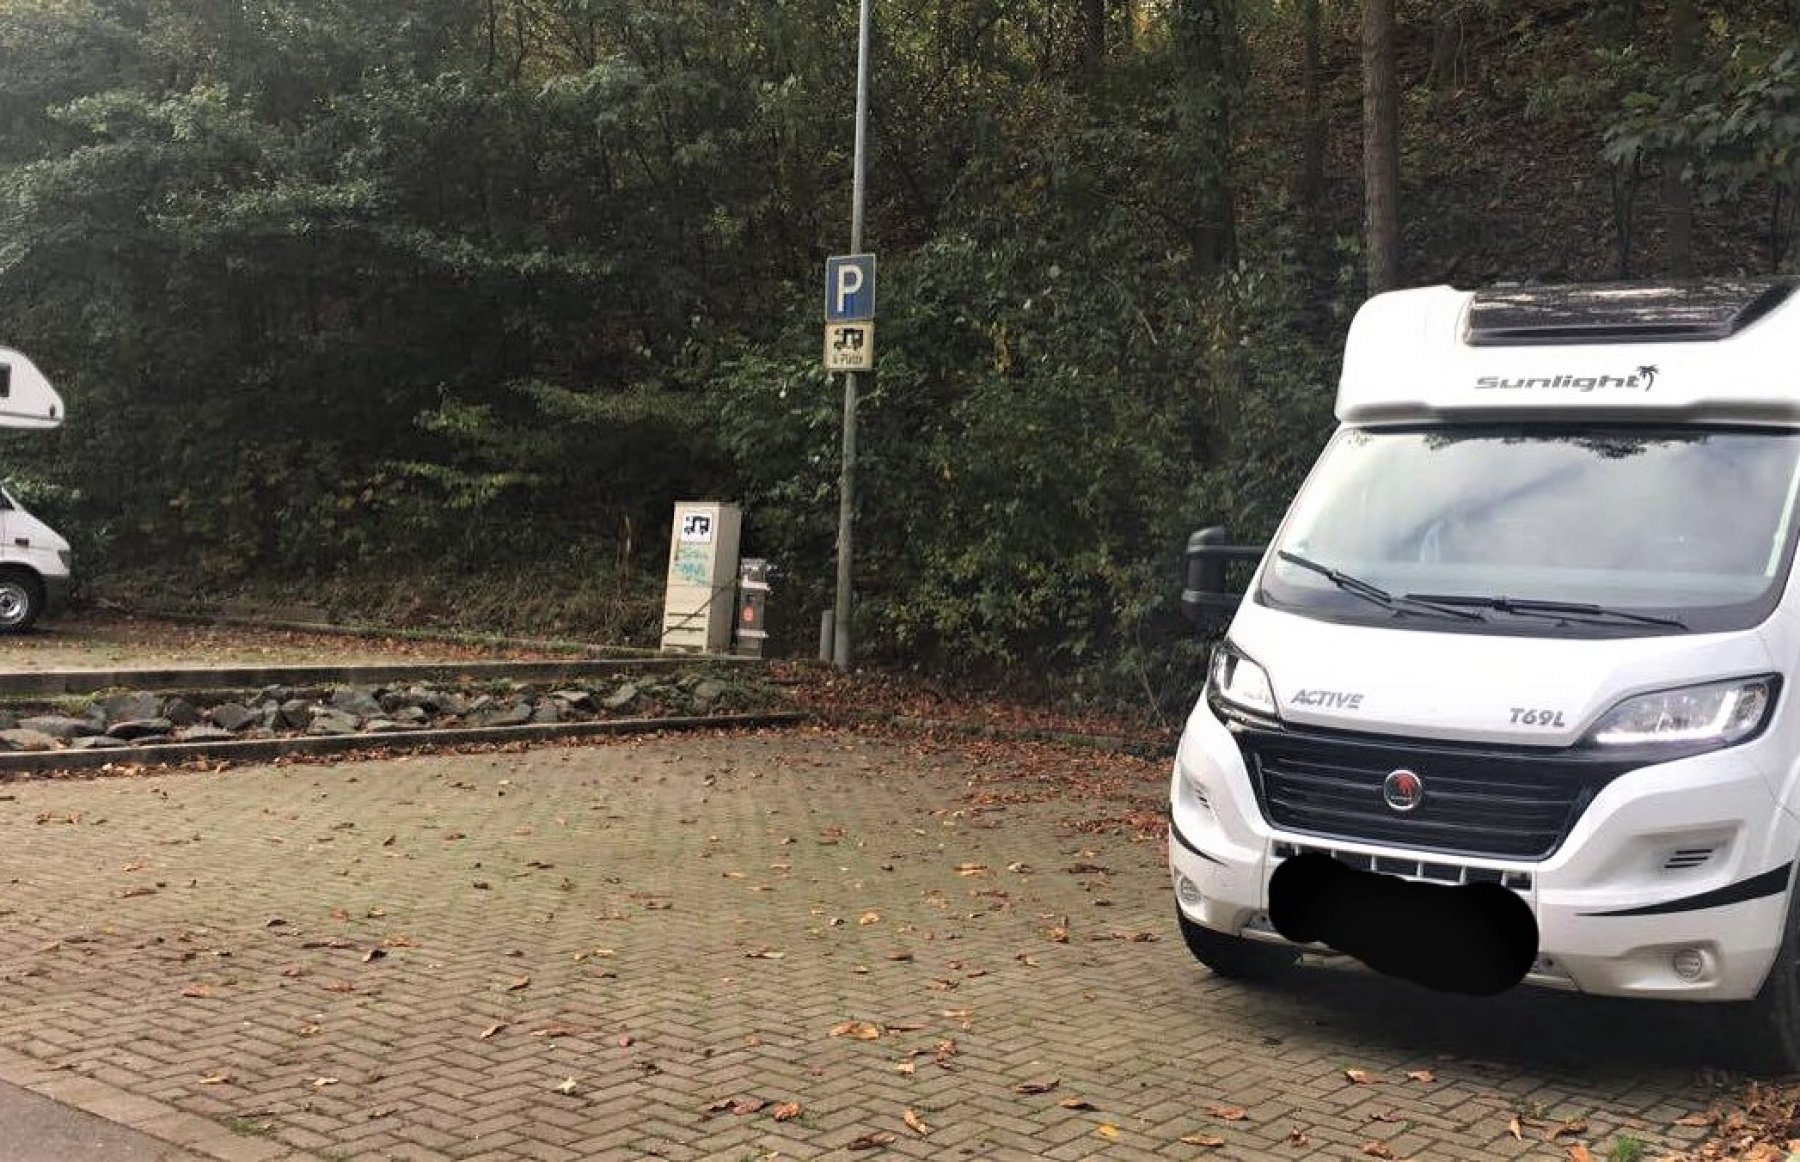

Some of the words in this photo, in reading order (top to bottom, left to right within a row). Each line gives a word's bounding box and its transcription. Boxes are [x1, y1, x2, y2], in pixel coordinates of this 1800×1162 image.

[837, 264, 864, 312] P
[1475, 374, 1640, 393] Sunlight
[1290, 688, 1365, 709] ACTIVE
[1509, 707, 1566, 728] T69L
